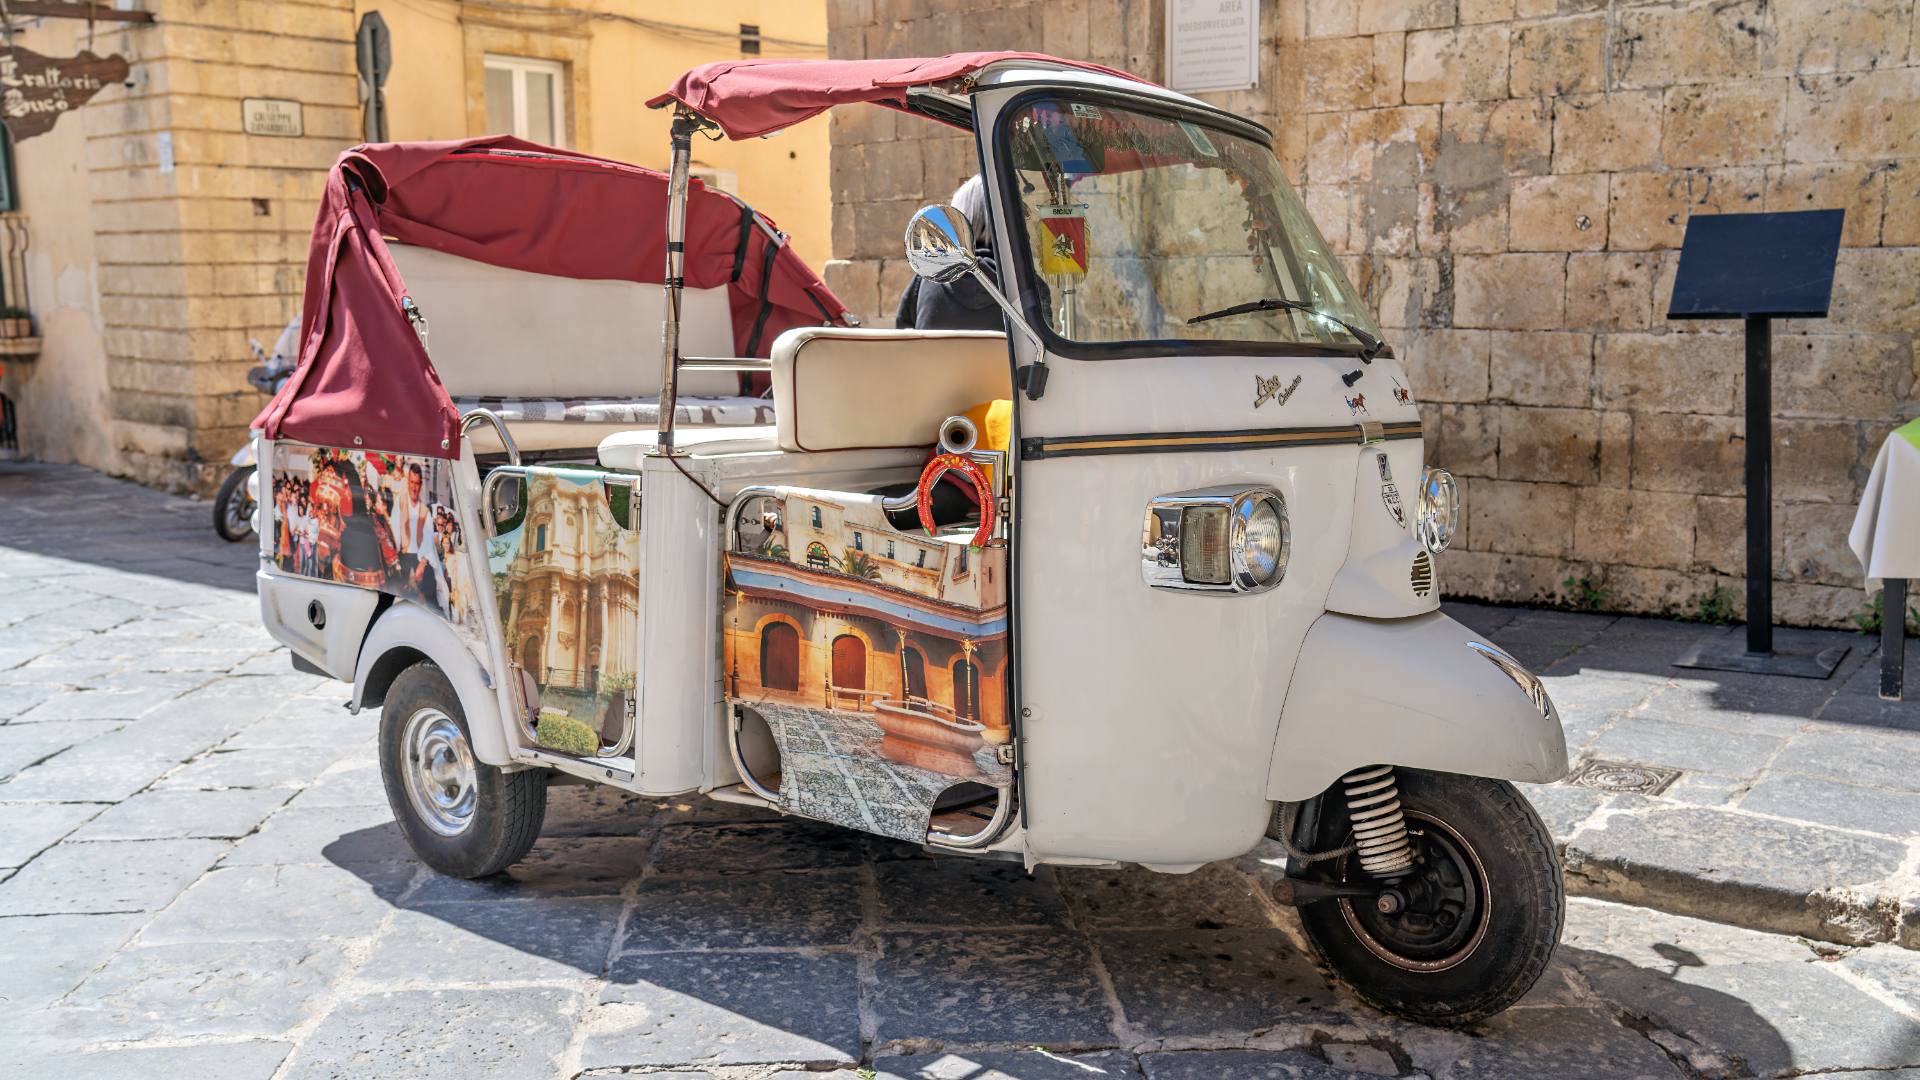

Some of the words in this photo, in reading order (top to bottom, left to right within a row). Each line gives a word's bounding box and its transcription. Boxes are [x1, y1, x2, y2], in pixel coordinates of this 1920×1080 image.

[1219, 0, 1242, 13] AREA
[0, 54, 100, 88] Trattoria
[264, 103, 281, 112] VIA
[1052, 208, 1073, 216] SICILY
